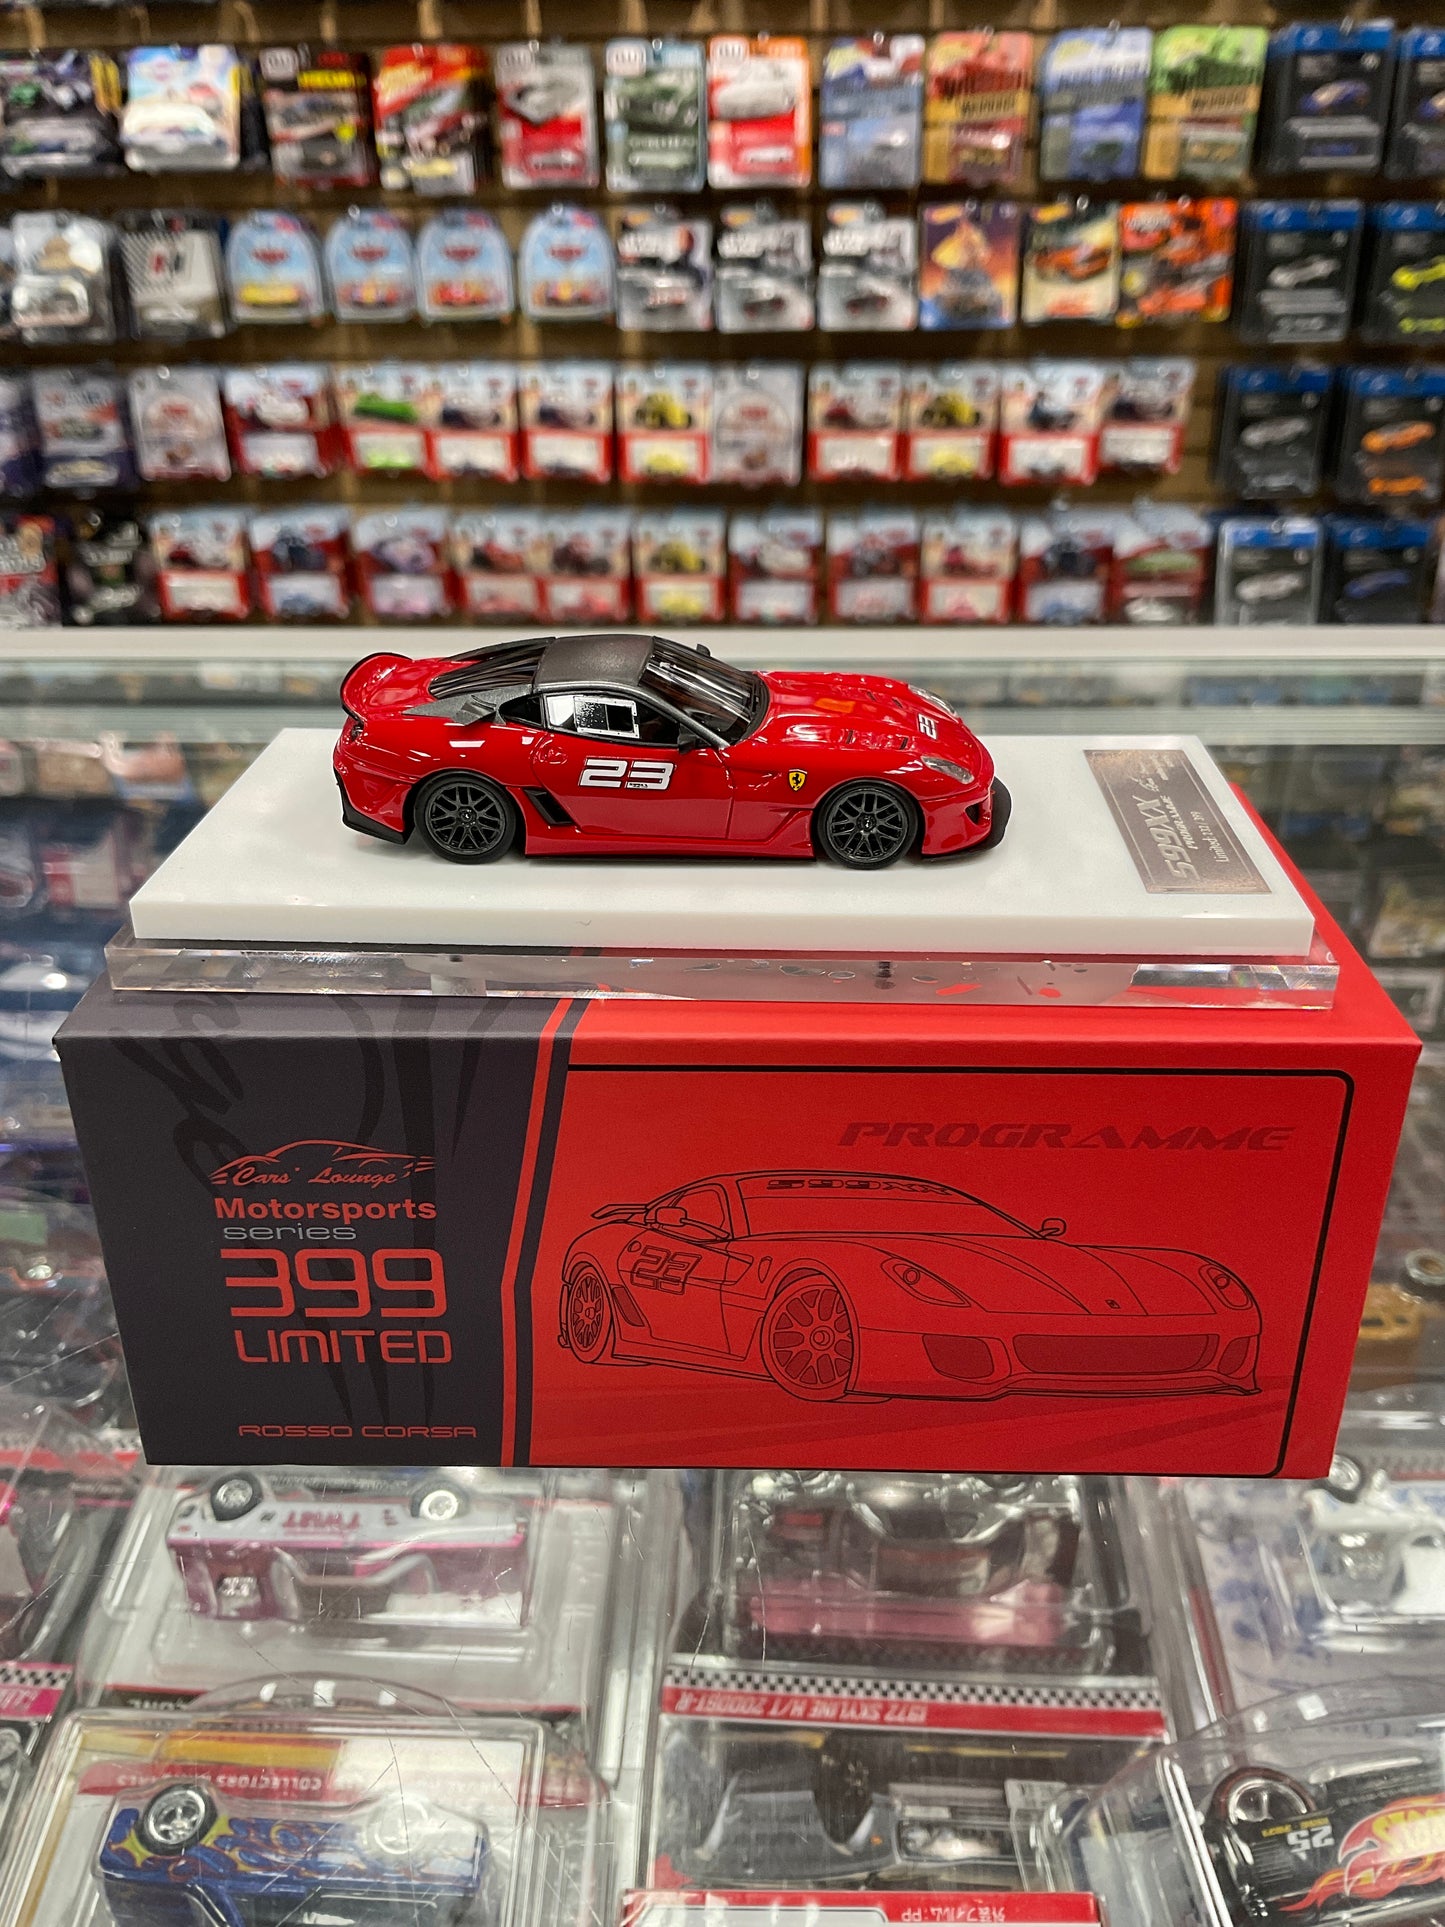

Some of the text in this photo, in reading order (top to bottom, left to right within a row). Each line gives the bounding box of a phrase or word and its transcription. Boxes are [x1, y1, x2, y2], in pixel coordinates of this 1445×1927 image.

[578, 758, 675, 790] 23
[1131, 794, 1201, 881] 599XX
[836, 1121, 1297, 1152] PROGRAMME
[214, 1197, 438, 1226] Motorsports
[223, 1222, 357, 1241] series
[220, 1248, 448, 1318] 399
[630, 1244, 703, 1296] 23
[235, 1330, 453, 1364] LIMITED
[239, 1425, 477, 1439] ROSSO CORSA
[807, 1701, 884, 1722] SKYLINE
[216, 1775, 323, 1791] COLLECTORS
[1287, 1824, 1336, 1854] 25
